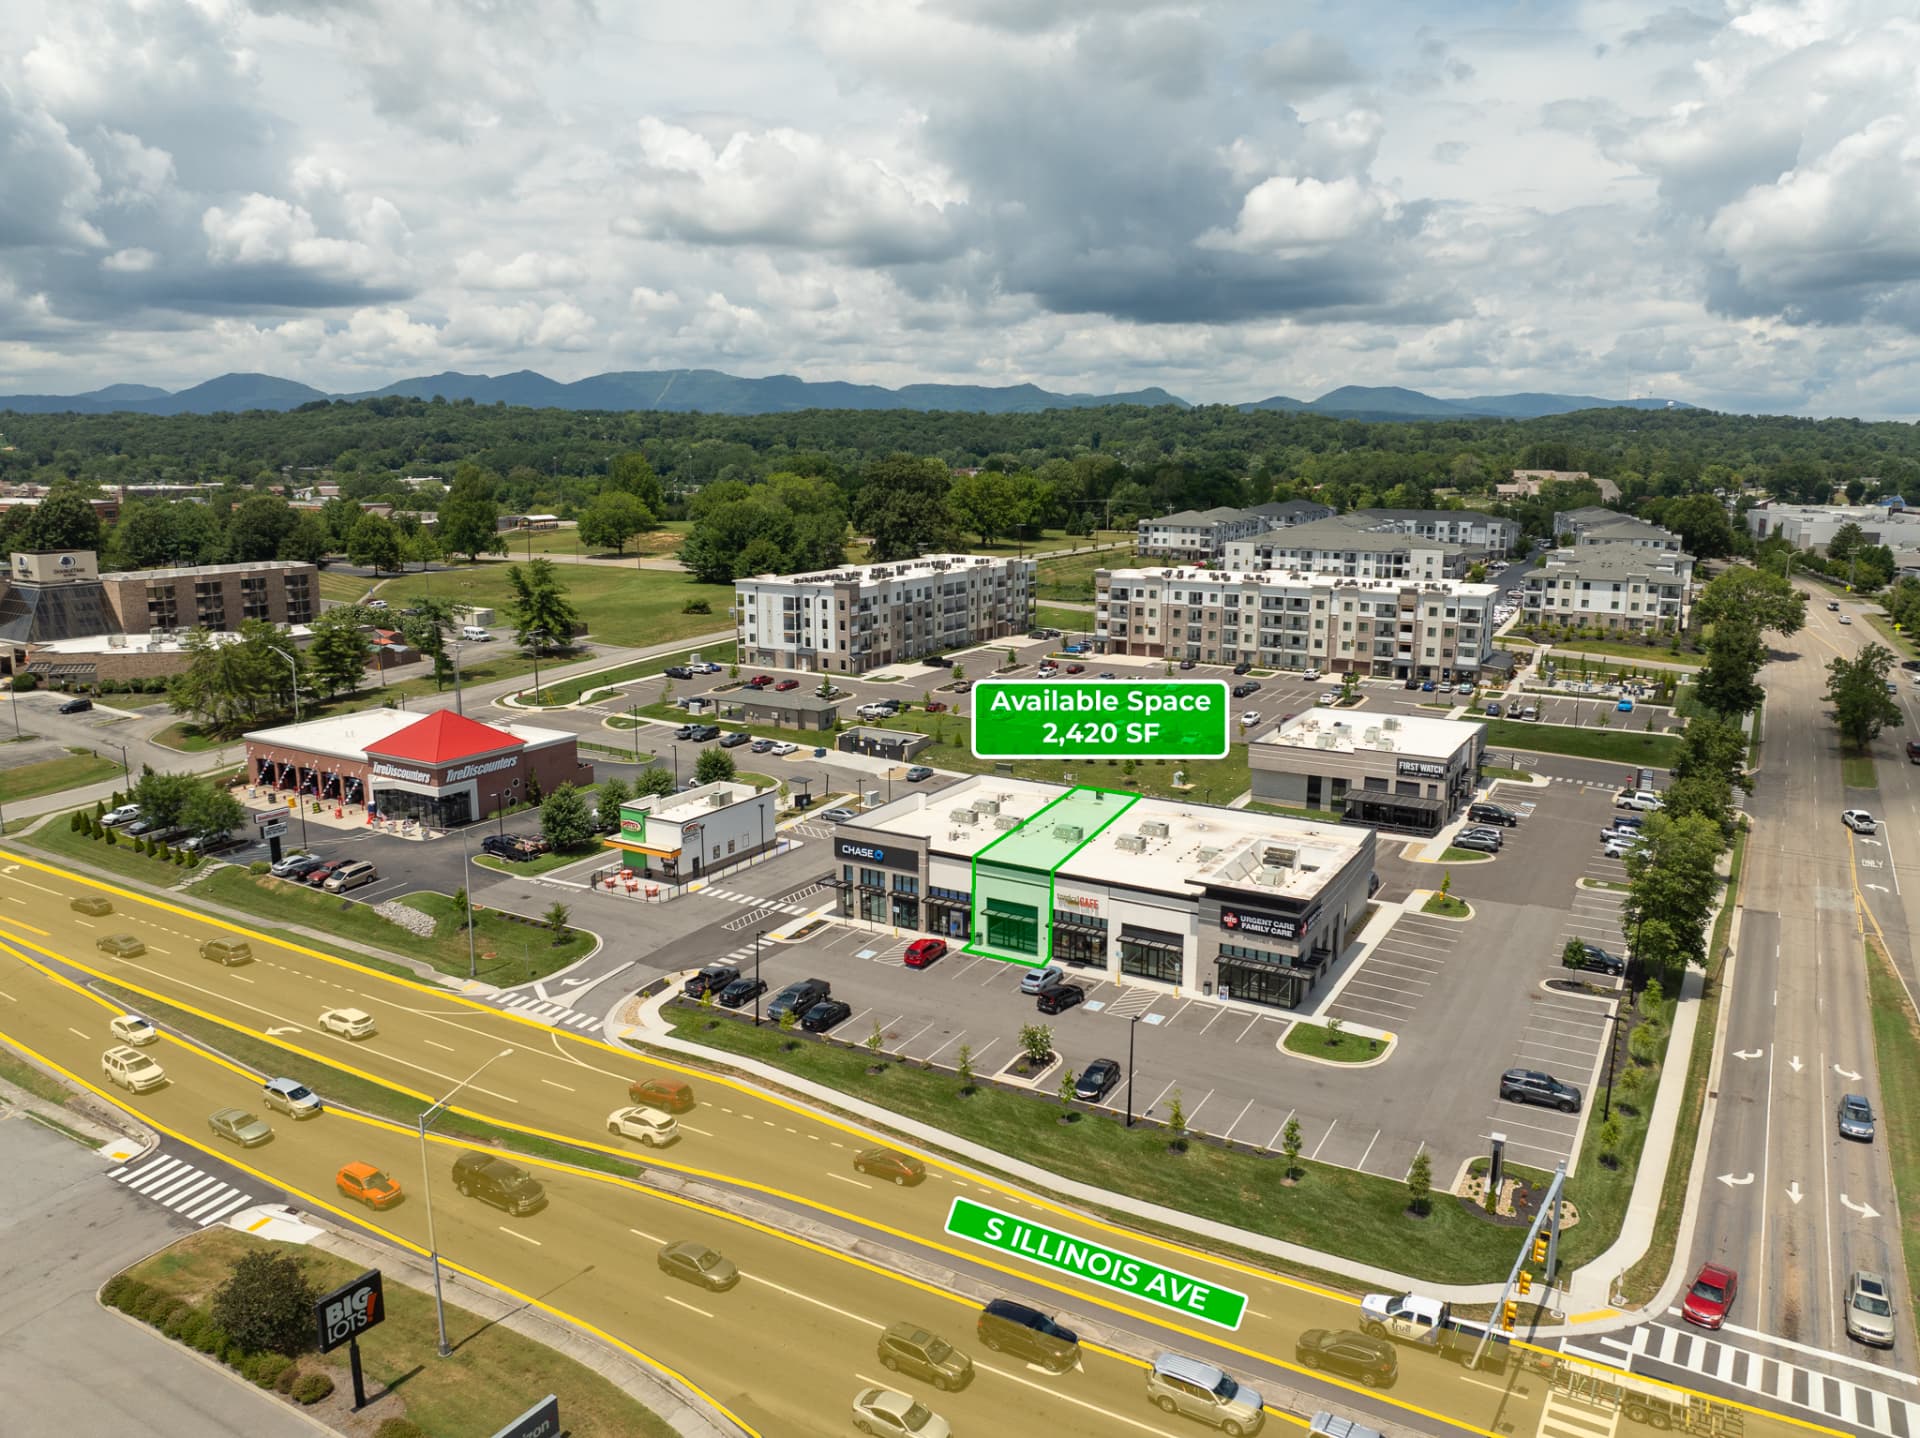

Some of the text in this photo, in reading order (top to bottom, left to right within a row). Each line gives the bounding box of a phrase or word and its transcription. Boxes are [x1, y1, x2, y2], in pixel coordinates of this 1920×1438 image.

[373, 761, 430, 783] TireDiscounters
[446, 755, 518, 782] TireDiscounters
[1399, 761, 1419, 771] FIRST
[1420, 763, 1444, 774] WATCH
[842, 844, 874, 858] CHASE
[1861, 858, 1883, 869] ONLY
[1240, 915, 1296, 931] URGENT CARE
[1241, 923, 1293, 938] FAMILY CARE
[326, 1286, 372, 1328] BIG
